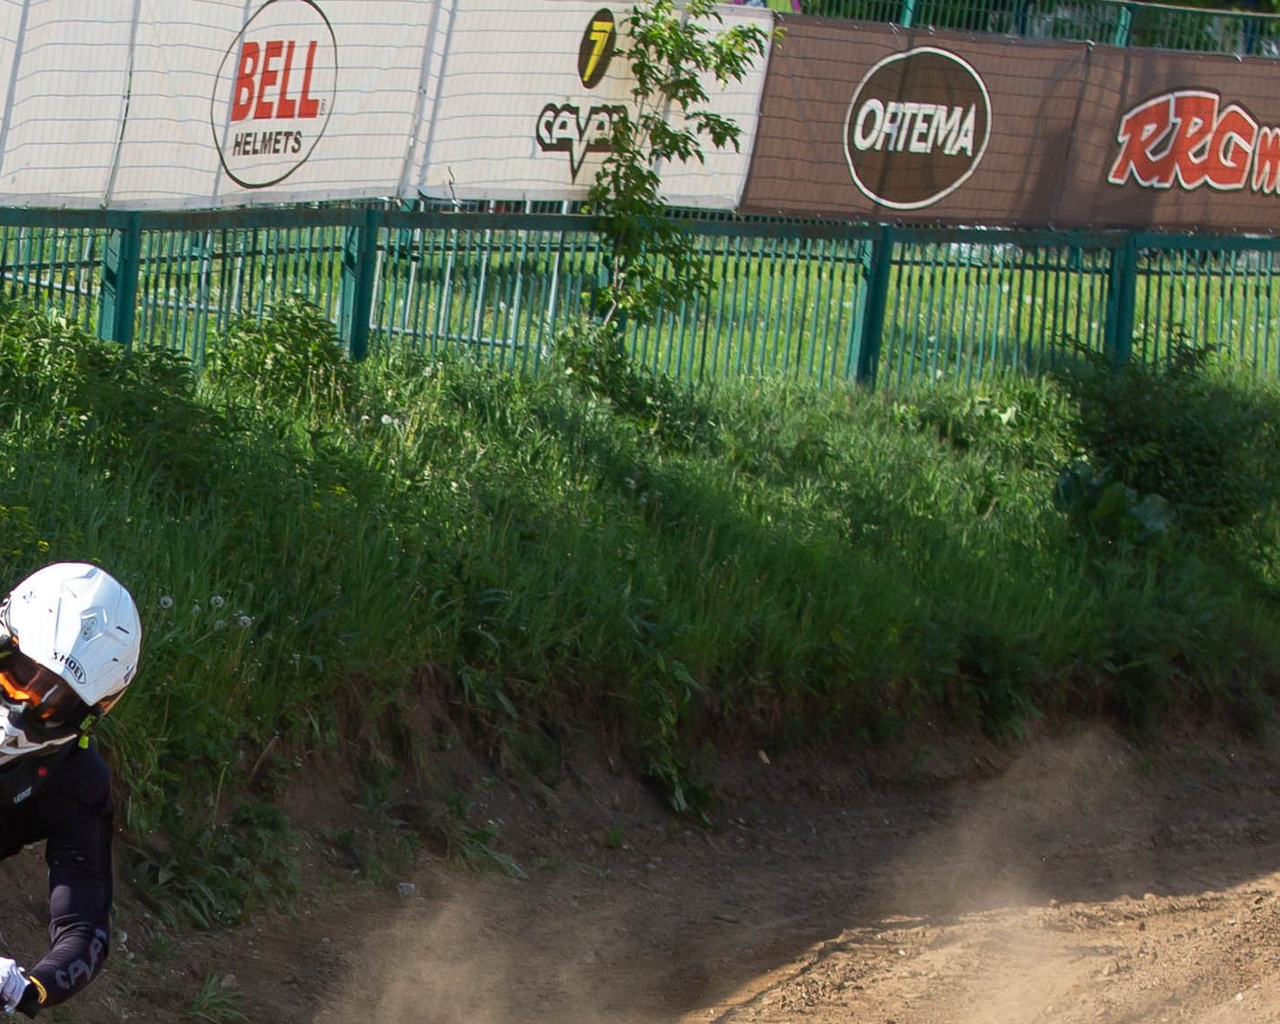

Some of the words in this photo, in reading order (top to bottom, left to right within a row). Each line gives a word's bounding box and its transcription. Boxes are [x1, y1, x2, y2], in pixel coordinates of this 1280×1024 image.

[230, 40, 320, 122] BELL
[582, 21, 614, 82] 7
[232, 130, 303, 157] HELMETS
[852, 97, 975, 157] ORTEMA
[1107, 90, 1260, 191] RRG
[51, 651, 84, 683] SHOEI
